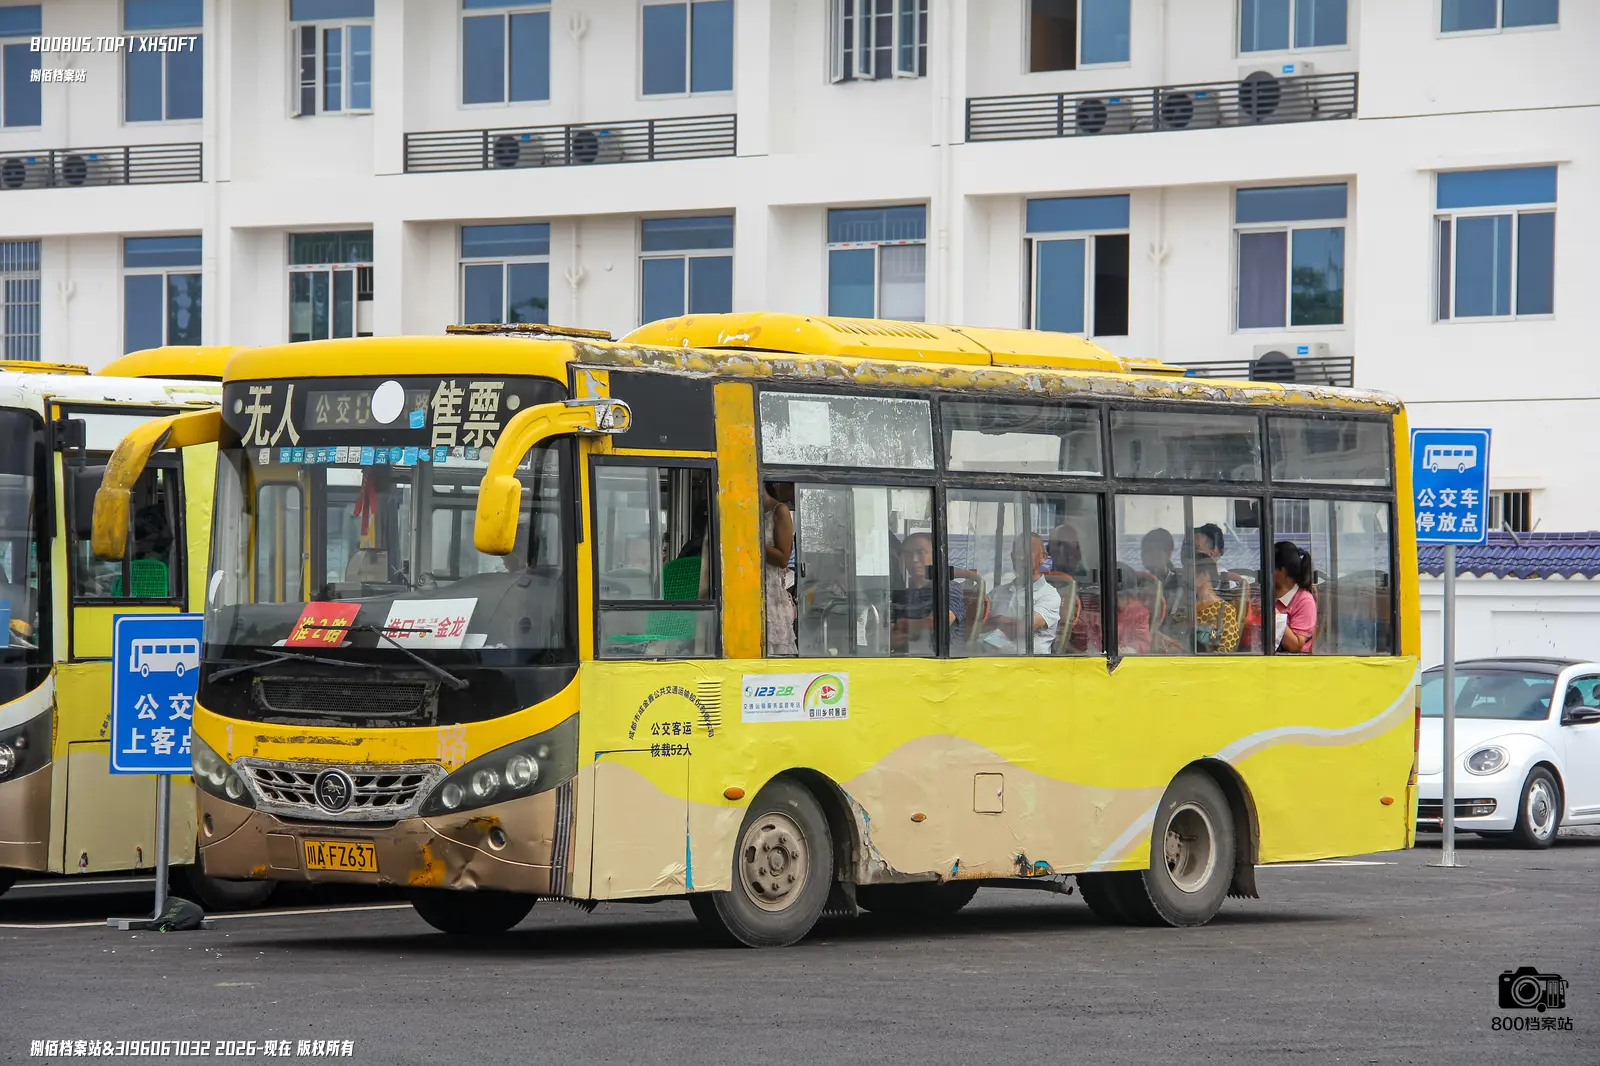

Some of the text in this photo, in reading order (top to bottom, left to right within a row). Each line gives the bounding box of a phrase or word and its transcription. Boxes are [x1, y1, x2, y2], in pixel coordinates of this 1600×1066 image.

[241, 380, 504, 448] 无人 售票
[1417, 487, 1479, 508] 公交车
[1416, 512, 1478, 532] 停放点
[434, 616, 466, 638] 金龙
[754, 686, 794, 697] 12328
[134, 693, 193, 720] 公交
[650, 721, 692, 735] 公交客运
[650, 742, 692, 757] 核载52人
